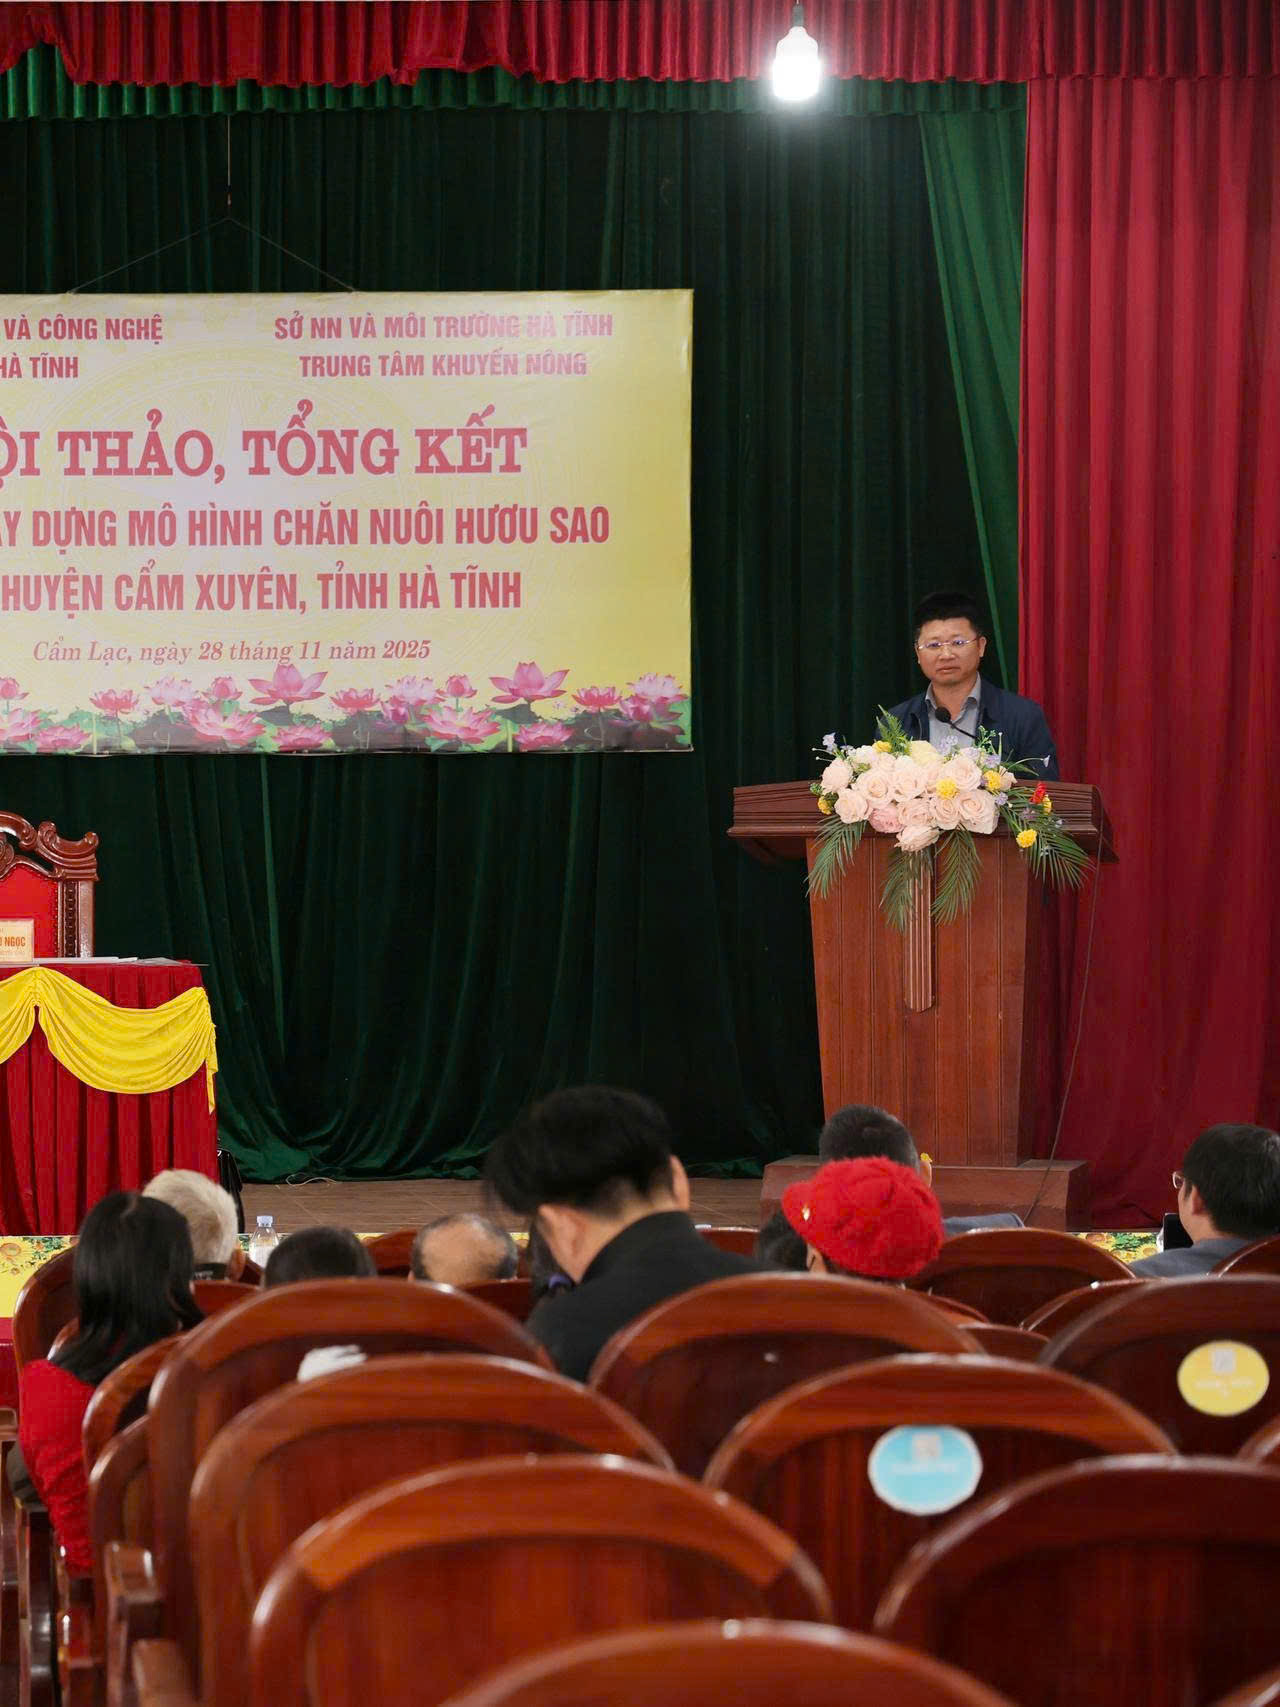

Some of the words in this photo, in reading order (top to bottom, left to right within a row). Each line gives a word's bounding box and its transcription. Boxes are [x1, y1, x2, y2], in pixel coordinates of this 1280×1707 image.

[4, 314, 31, 340] VÀ
[38, 314, 97, 340] CÔNG
[105, 314, 163, 344] NGHỆ
[275, 311, 303, 339] SỞ
[311, 317, 341, 338] NN
[349, 312, 376, 338] VÀ
[384, 312, 425, 338] MÔI
[433, 311, 519, 338] TRƯỜNG
[527, 311, 556, 337] HÀ
[562, 311, 613, 336] TĨNH
[30, 352, 79, 378] TĨNH
[299, 354, 371, 377] TRUNG
[378, 350, 424, 376] TÂM
[432, 347, 518, 376] KHUYẾN
[526, 349, 586, 375] NÔNG
[57, 408, 226, 485] THẢO,
[242, 399, 400, 476] TỔNG
[415, 404, 527, 474] KẾT
[32, 506, 117, 555] DỰNG
[128, 502, 177, 547] MÔ
[188, 502, 263, 546] HÌNH
[274, 501, 358, 545] CHĂN
[370, 501, 443, 544] NUÔI
[455, 505, 538, 544] HƯƠU
[550, 505, 609, 543] SAO
[1, 566, 103, 619] HUYỆN
[114, 559, 184, 611] CẨM
[195, 566, 306, 615] XUYÊN,
[317, 560, 387, 609] TỈNH
[399, 565, 440, 609] HÀ
[450, 565, 521, 608] TĨNH
[33, 635, 81, 662] Cẩm
[88, 641, 132, 664] Lạc,
[139, 641, 192, 665] ngày
[198, 641, 223, 662] 28
[229, 641, 291, 665] tháng
[299, 641, 321, 660] 11
[328, 641, 376, 660] năm
[382, 639, 431, 659] 2025
[4, 935, 26, 949] NGỌC
